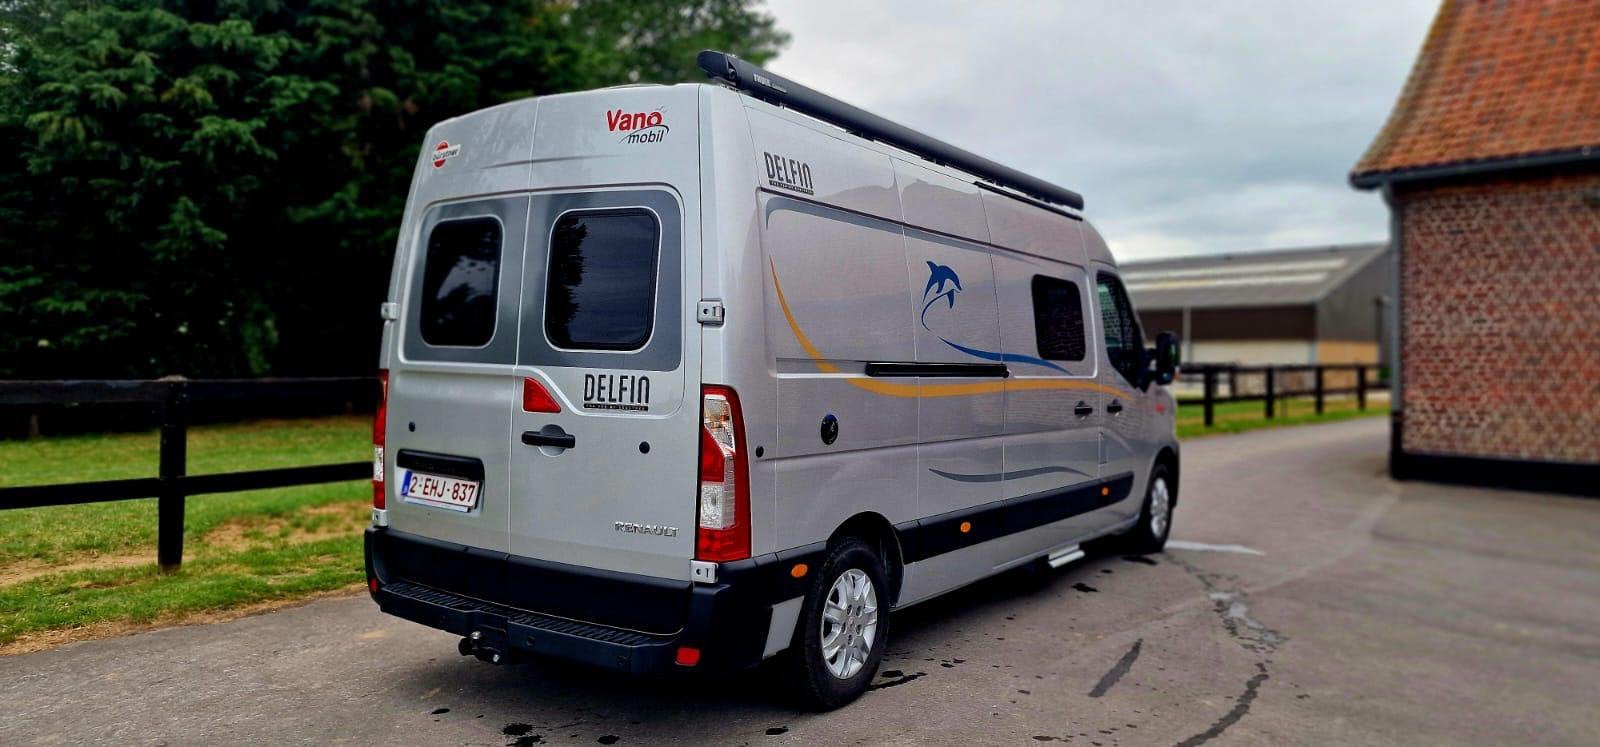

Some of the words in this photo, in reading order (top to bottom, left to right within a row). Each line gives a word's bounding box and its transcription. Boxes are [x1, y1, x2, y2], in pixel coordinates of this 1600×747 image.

[606, 109, 663, 132] Vano
[627, 129, 665, 144] mobil
[763, 151, 813, 190] DELFIN
[583, 373, 650, 404] DELFIN
[409, 476, 476, 503] 2-EHJ-837
[614, 521, 679, 538] RENAULT
